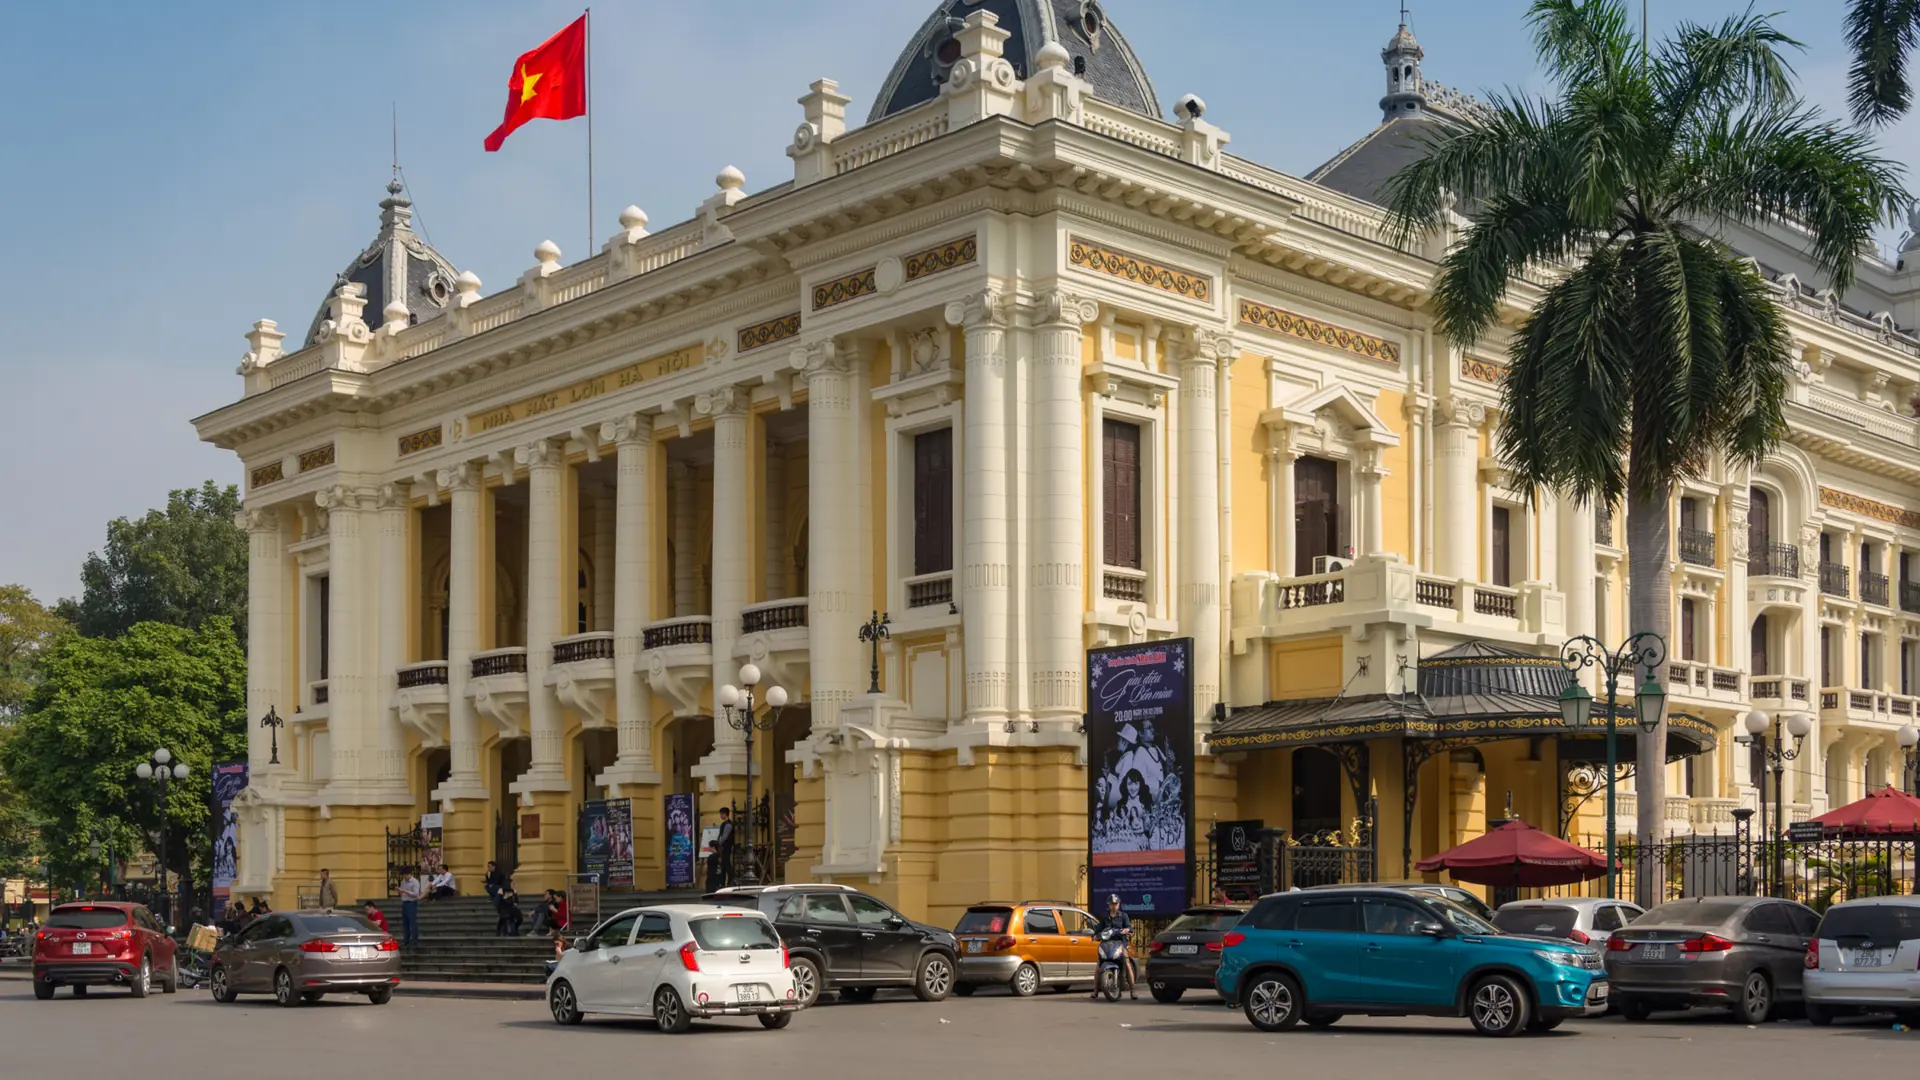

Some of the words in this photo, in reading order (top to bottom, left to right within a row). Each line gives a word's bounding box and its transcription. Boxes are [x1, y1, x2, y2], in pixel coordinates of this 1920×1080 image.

[483, 405, 515, 430] NHÀ
[526, 394, 559, 417] HÁT
[570, 379, 606, 403] LỚN
[619, 364, 644, 388] HÀ
[658, 350, 690, 376] NỘI
